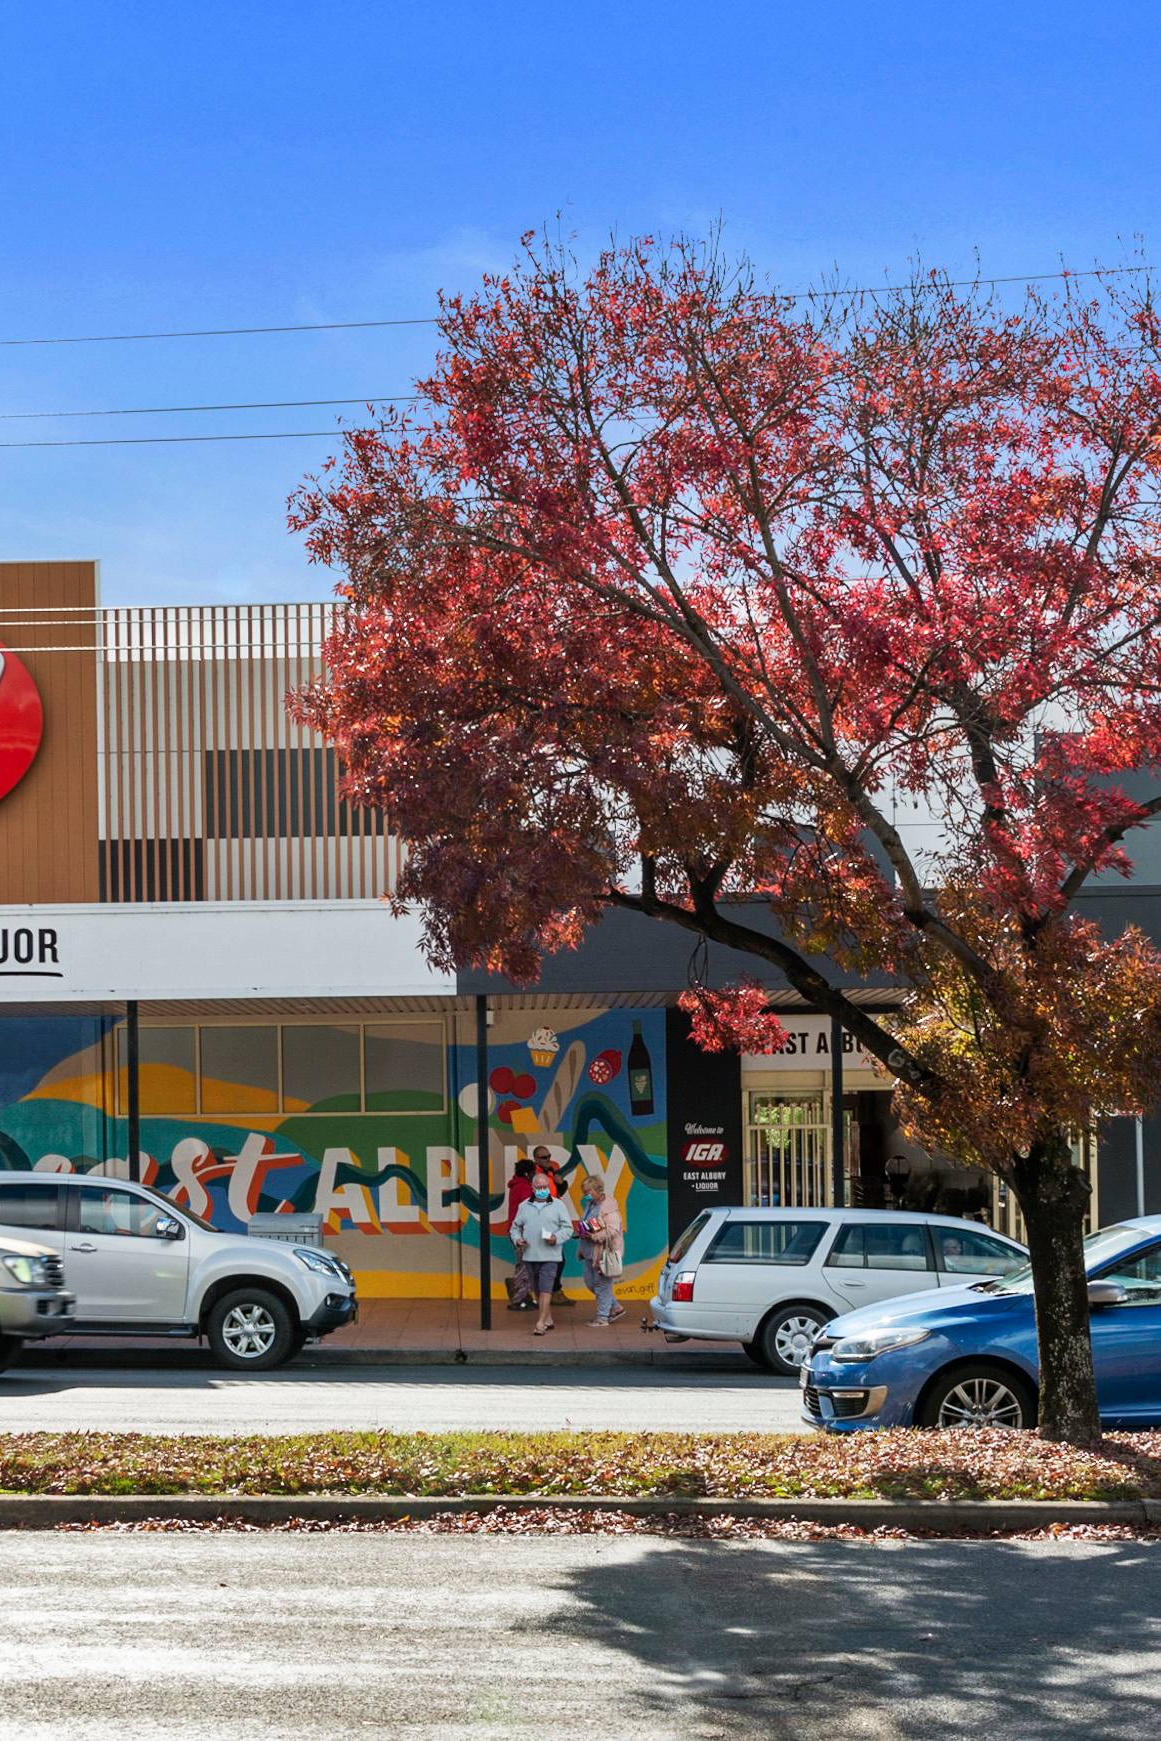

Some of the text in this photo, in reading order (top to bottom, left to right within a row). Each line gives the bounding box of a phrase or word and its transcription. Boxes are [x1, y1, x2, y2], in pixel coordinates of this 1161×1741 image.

[684, 1143, 725, 1161] IGA
[683, 1171, 727, 1181] EAST ALBURY
